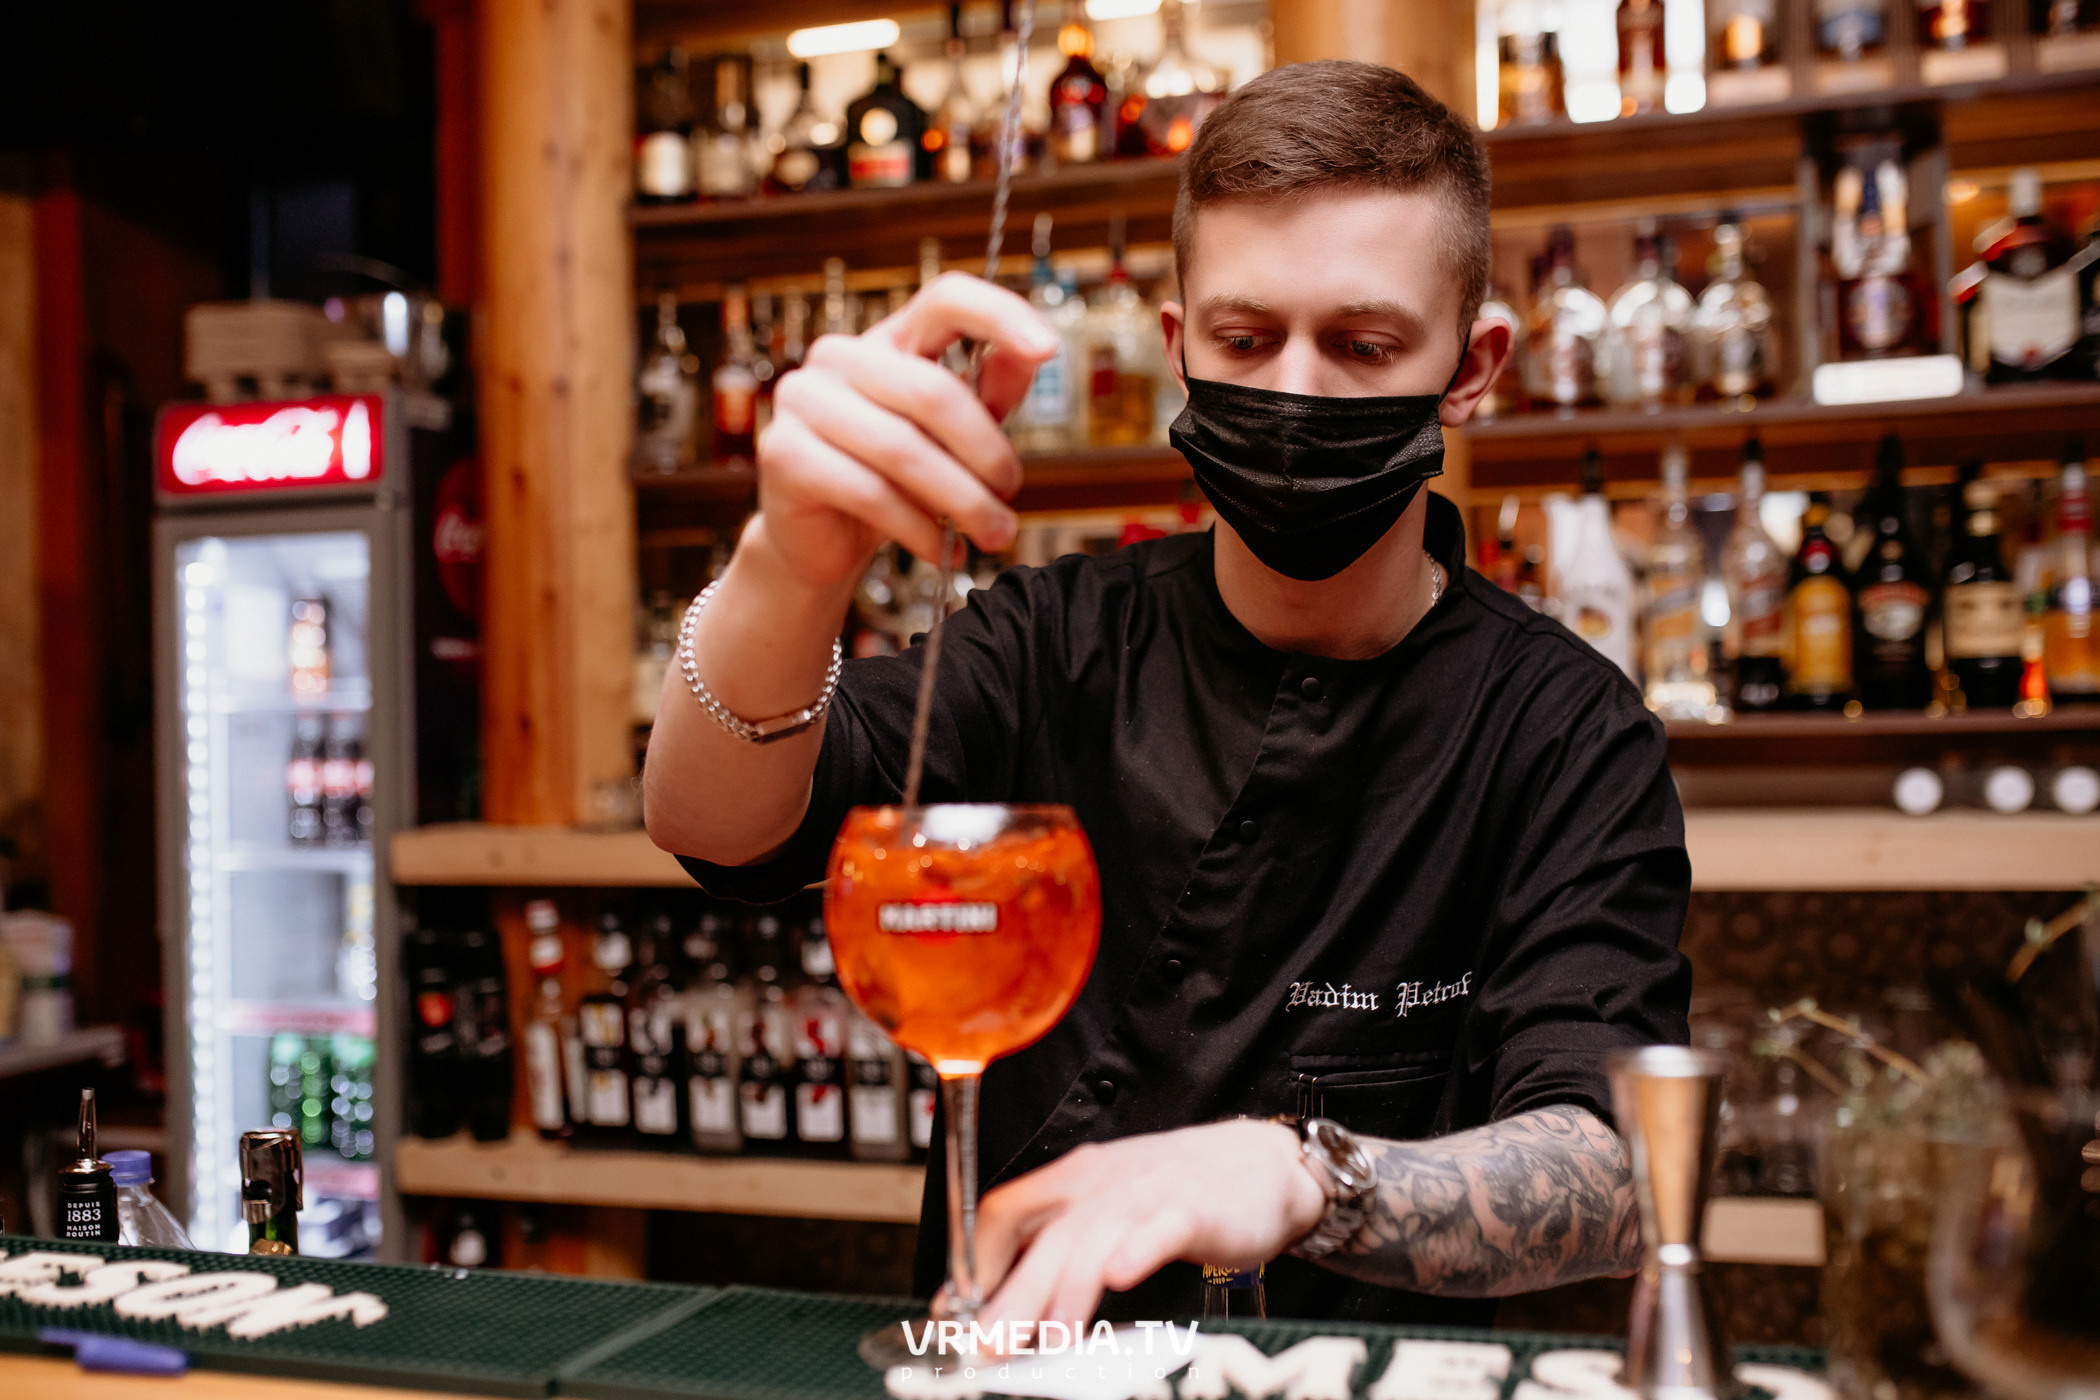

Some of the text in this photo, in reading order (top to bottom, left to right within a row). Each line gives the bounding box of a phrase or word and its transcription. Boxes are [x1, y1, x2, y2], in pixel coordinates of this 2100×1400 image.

[67, 1201, 101, 1209] DEPUIS
[66, 1208, 102, 1223] 1883
[66, 1223, 101, 1232] MAISON
[65, 1230, 101, 1238] ROUTIN
[0, 1249, 390, 1342] ESON
